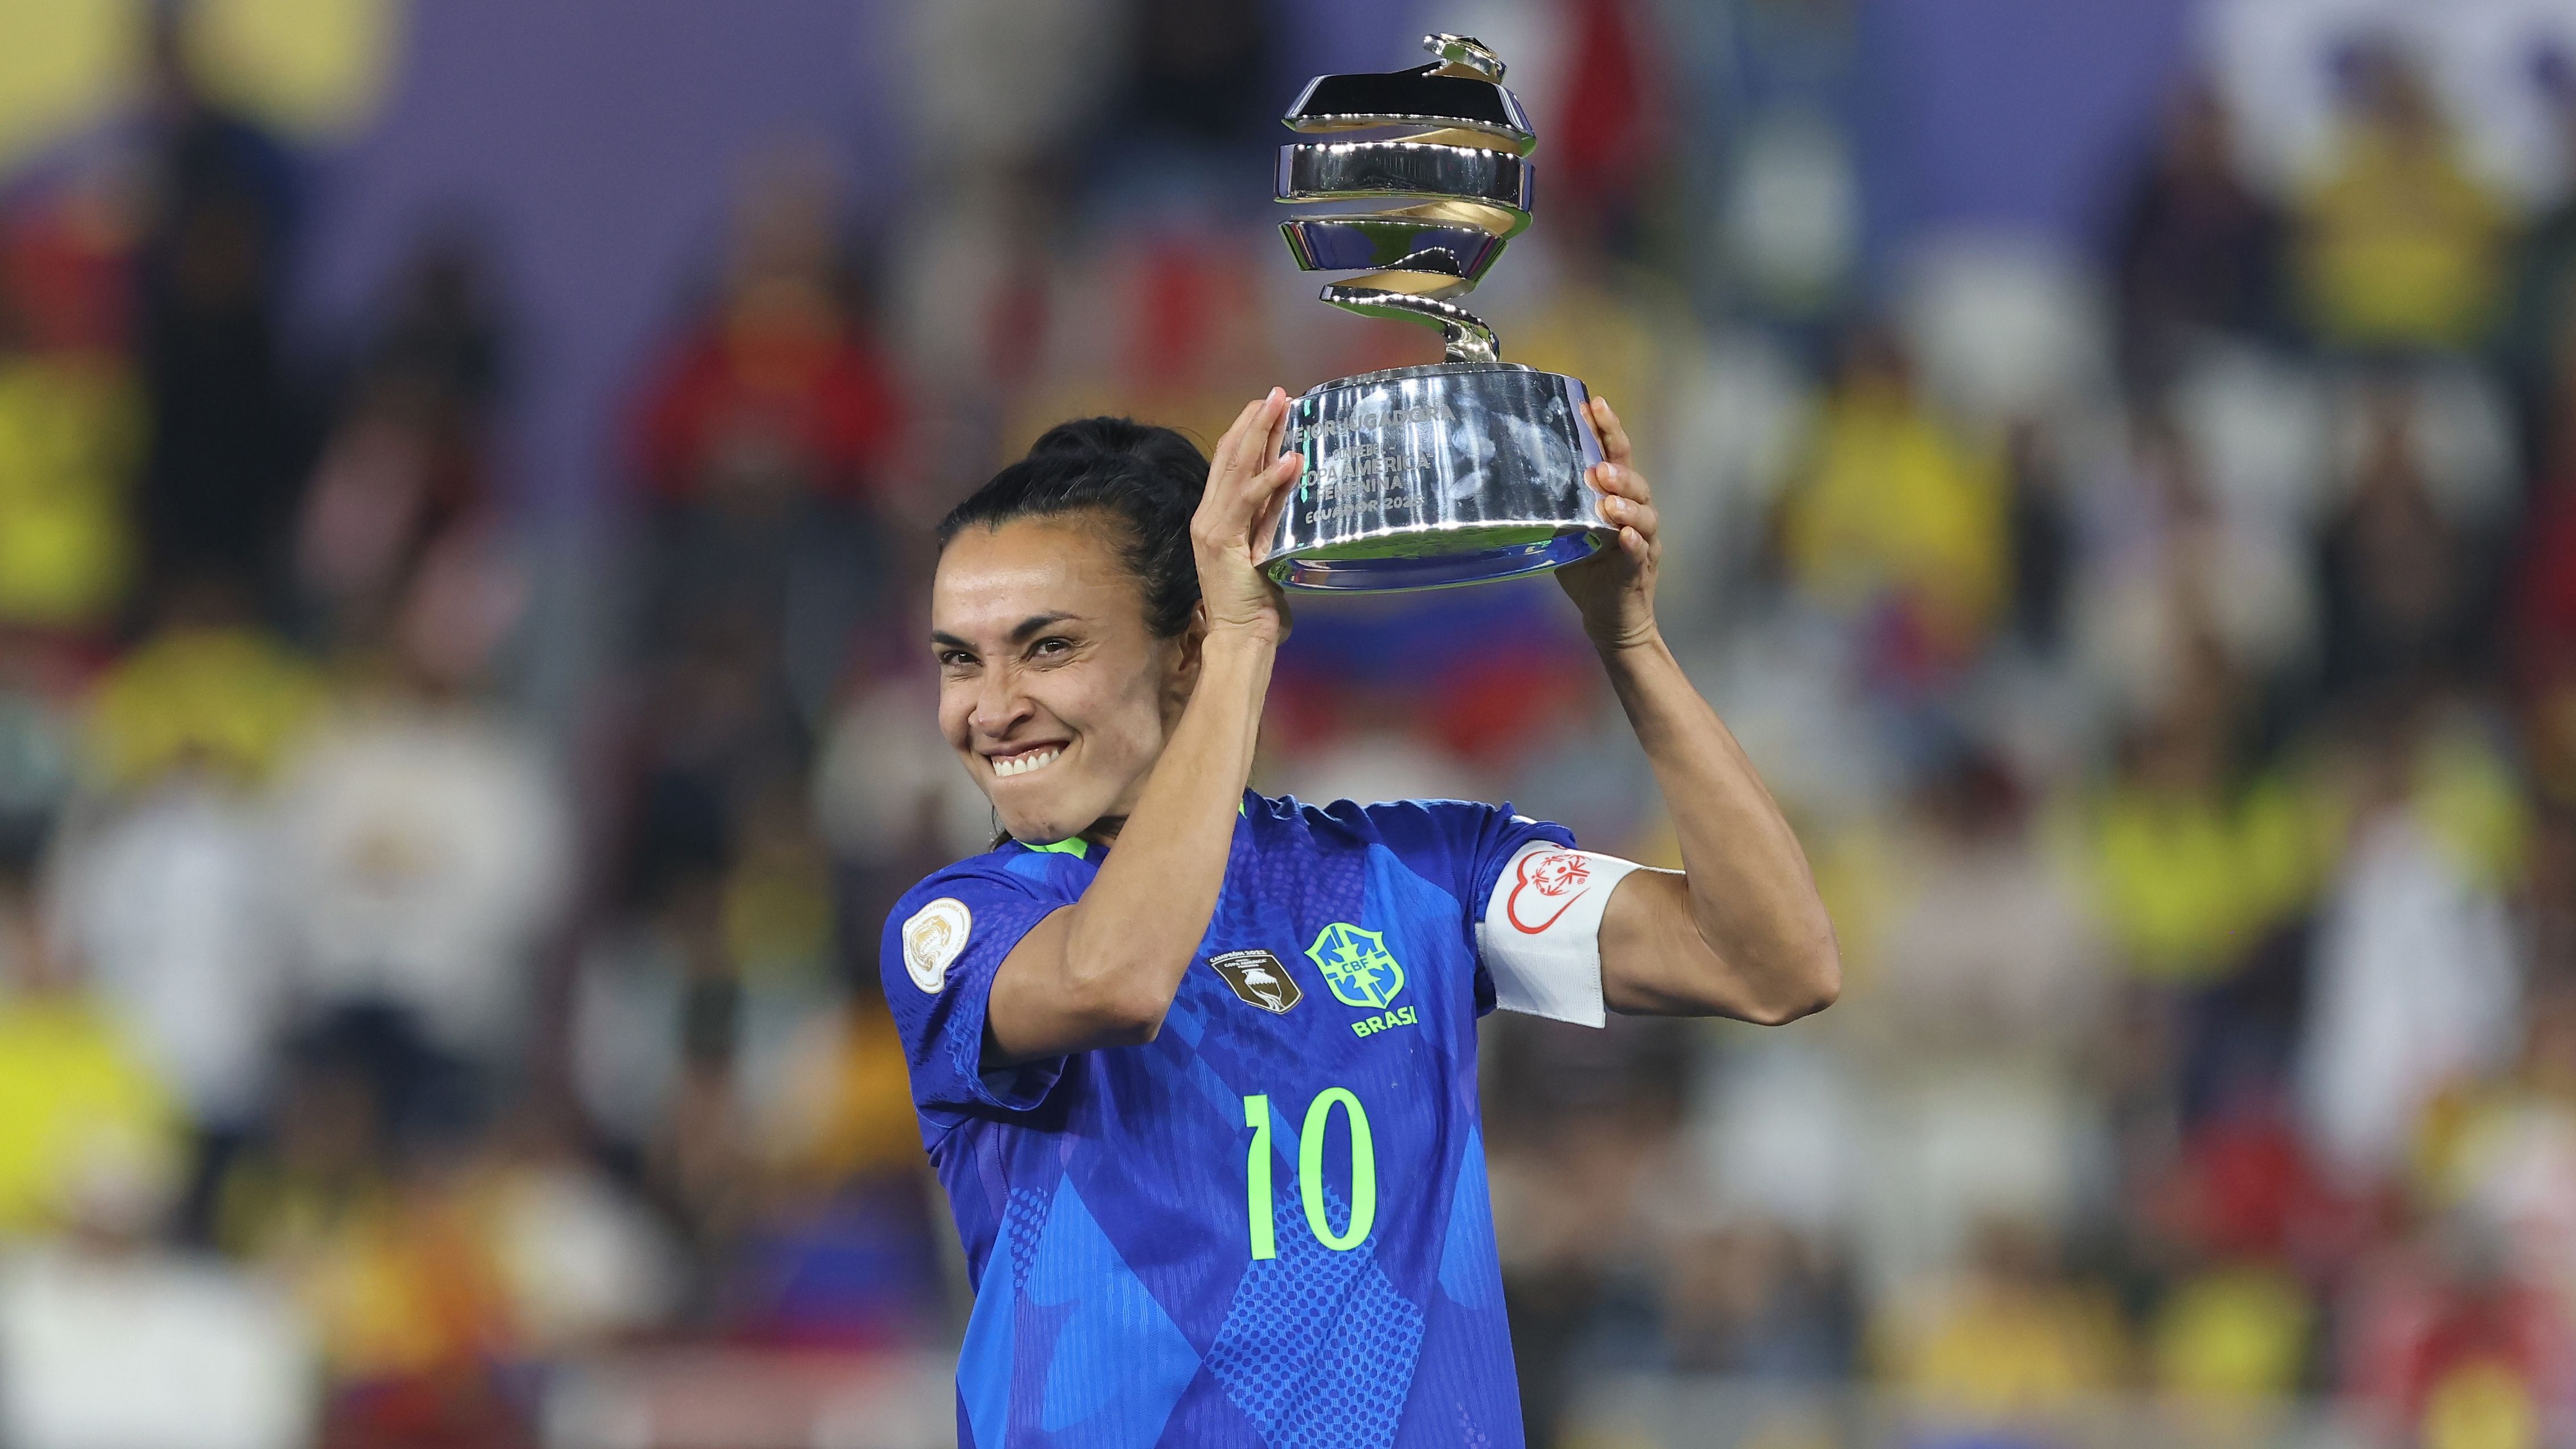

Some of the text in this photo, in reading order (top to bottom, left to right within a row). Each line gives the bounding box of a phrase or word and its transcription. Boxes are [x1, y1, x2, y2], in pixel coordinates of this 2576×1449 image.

[1284, 405, 1456, 447] MEJOR JUGADORA
[1342, 452, 1430, 479] AMERICA
[1317, 474, 1403, 502] FEMENINA
[1305, 499, 1379, 524] ECUADOR
[1341, 957, 1369, 974] CBF
[1350, 1005, 1418, 1038] BRASI
[1243, 1087, 1377, 1260] 10
